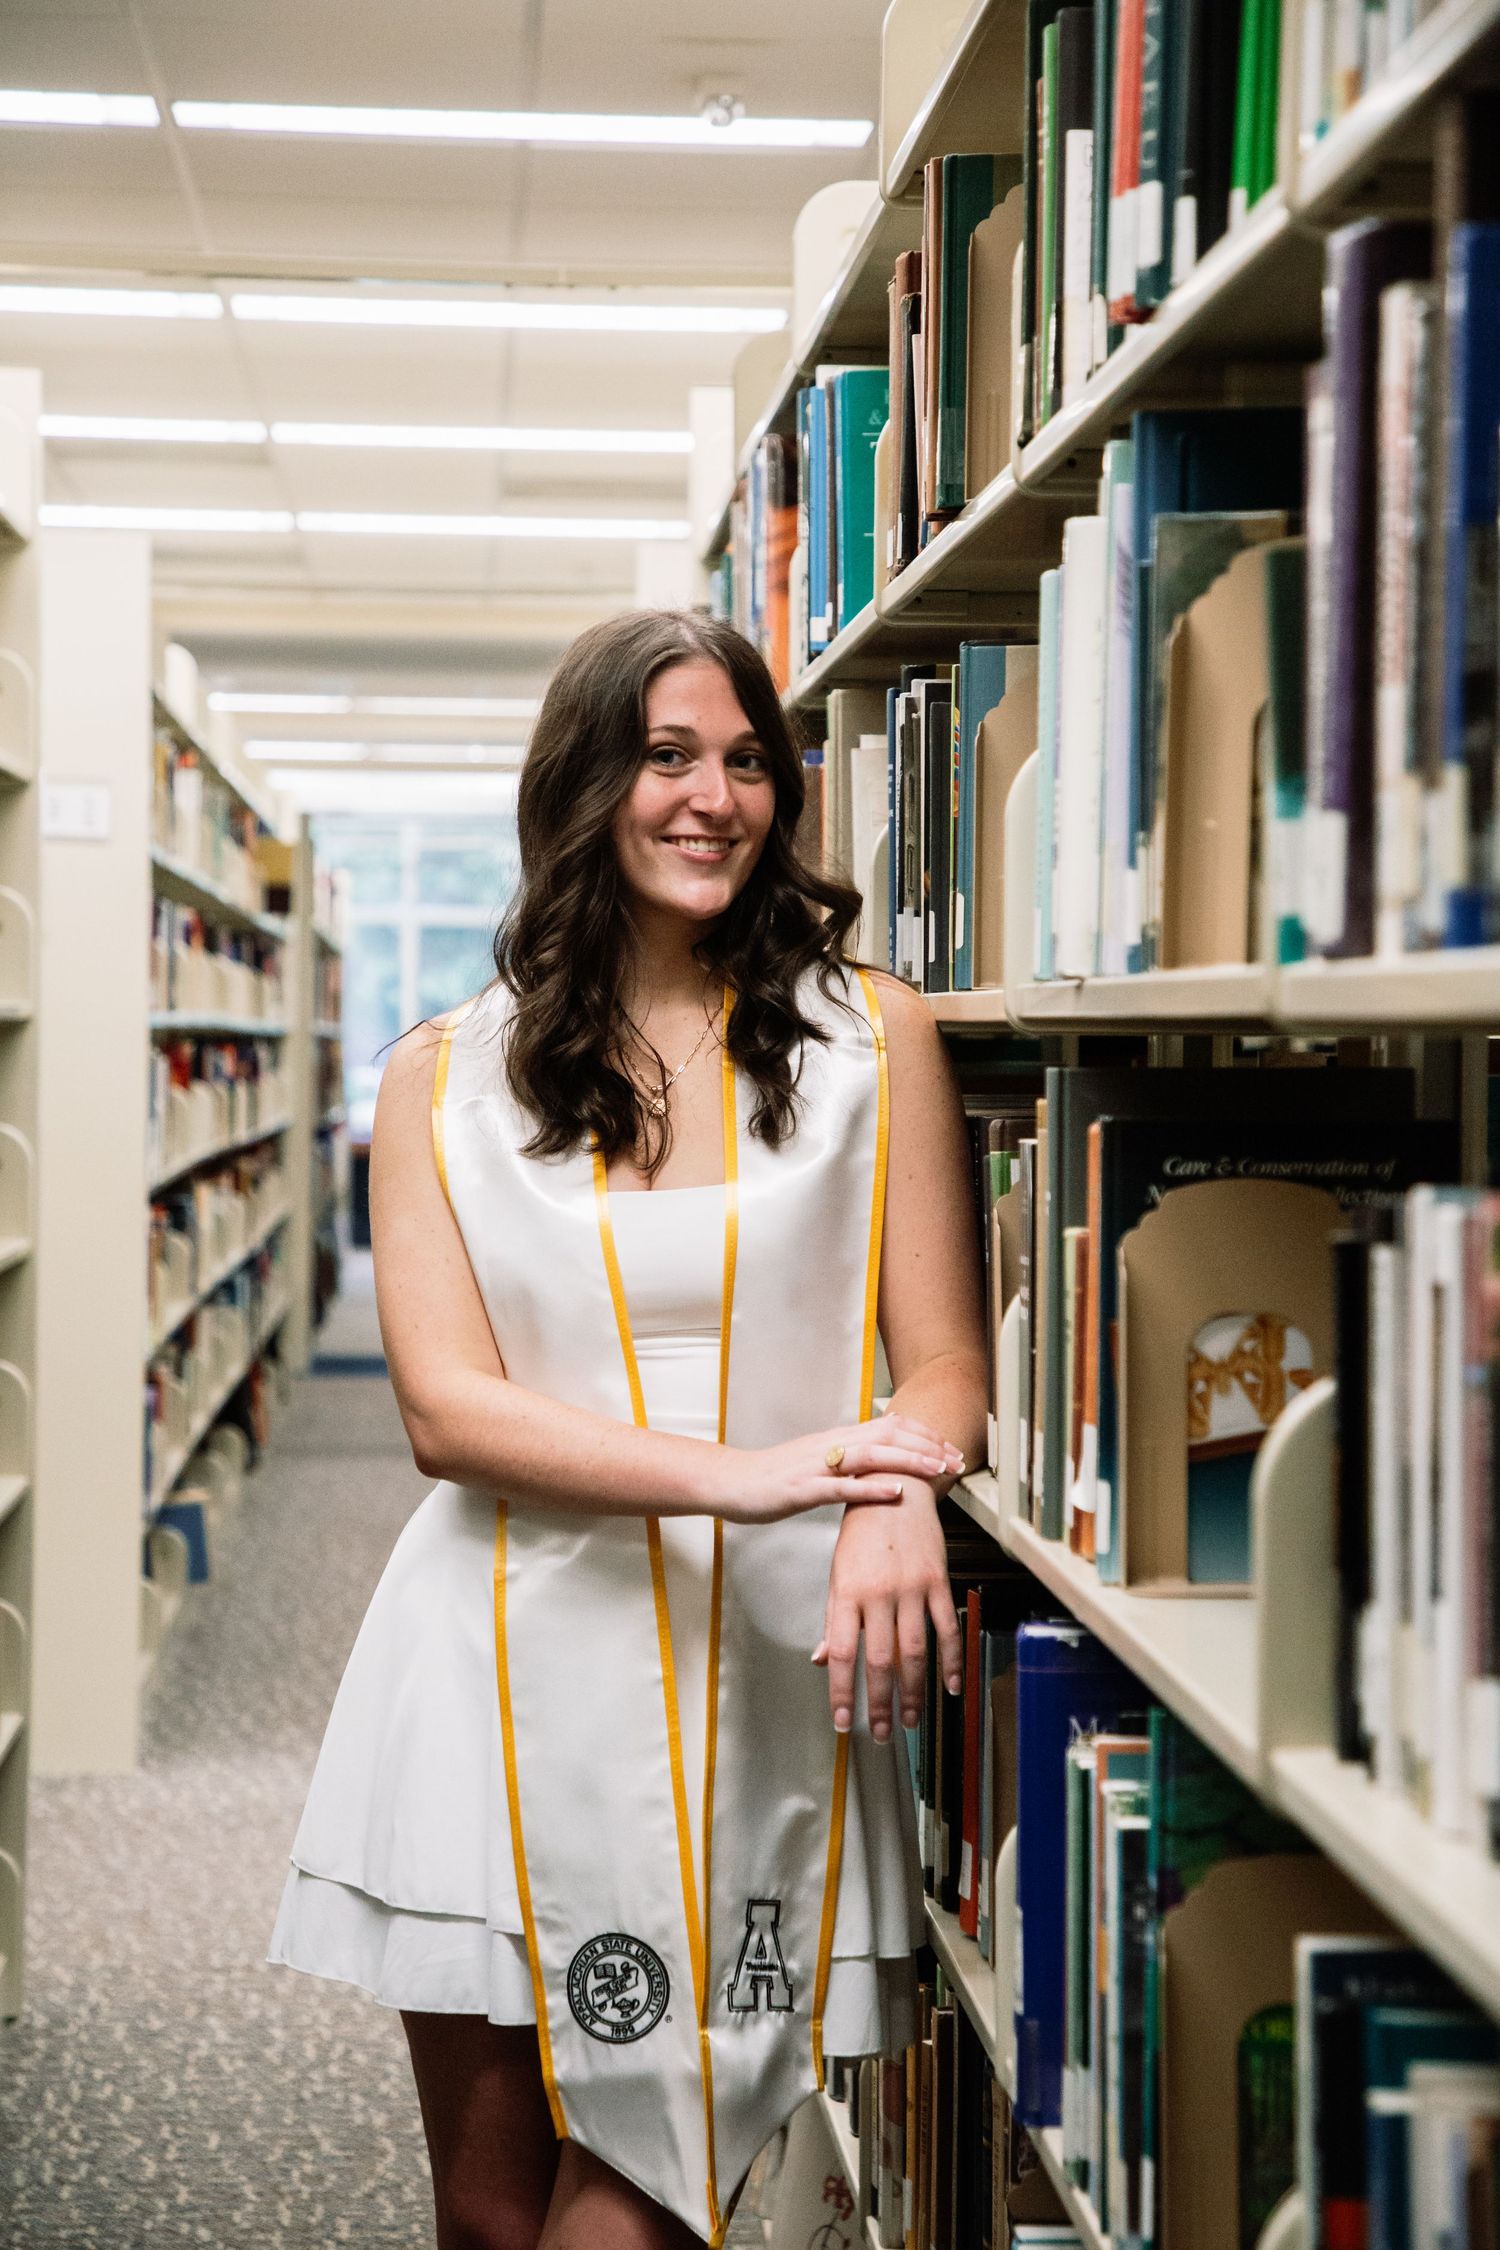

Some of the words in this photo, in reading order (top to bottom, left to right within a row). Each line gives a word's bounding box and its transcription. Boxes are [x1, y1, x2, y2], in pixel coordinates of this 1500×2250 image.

[1162, 1155, 1212, 1176] Care
[1215, 1155, 1233, 1176] &
[1237, 1156, 1370, 1177] Conservation
[1376, 1159, 1396, 1182] of
[572, 1944, 599, 2027] APPALACHIAN
[600, 1939, 633, 1953] STATE
[635, 1947, 664, 2018] UNIVERSITY
[728, 1899, 793, 2012] A
[611, 2023, 636, 2038] 1899
